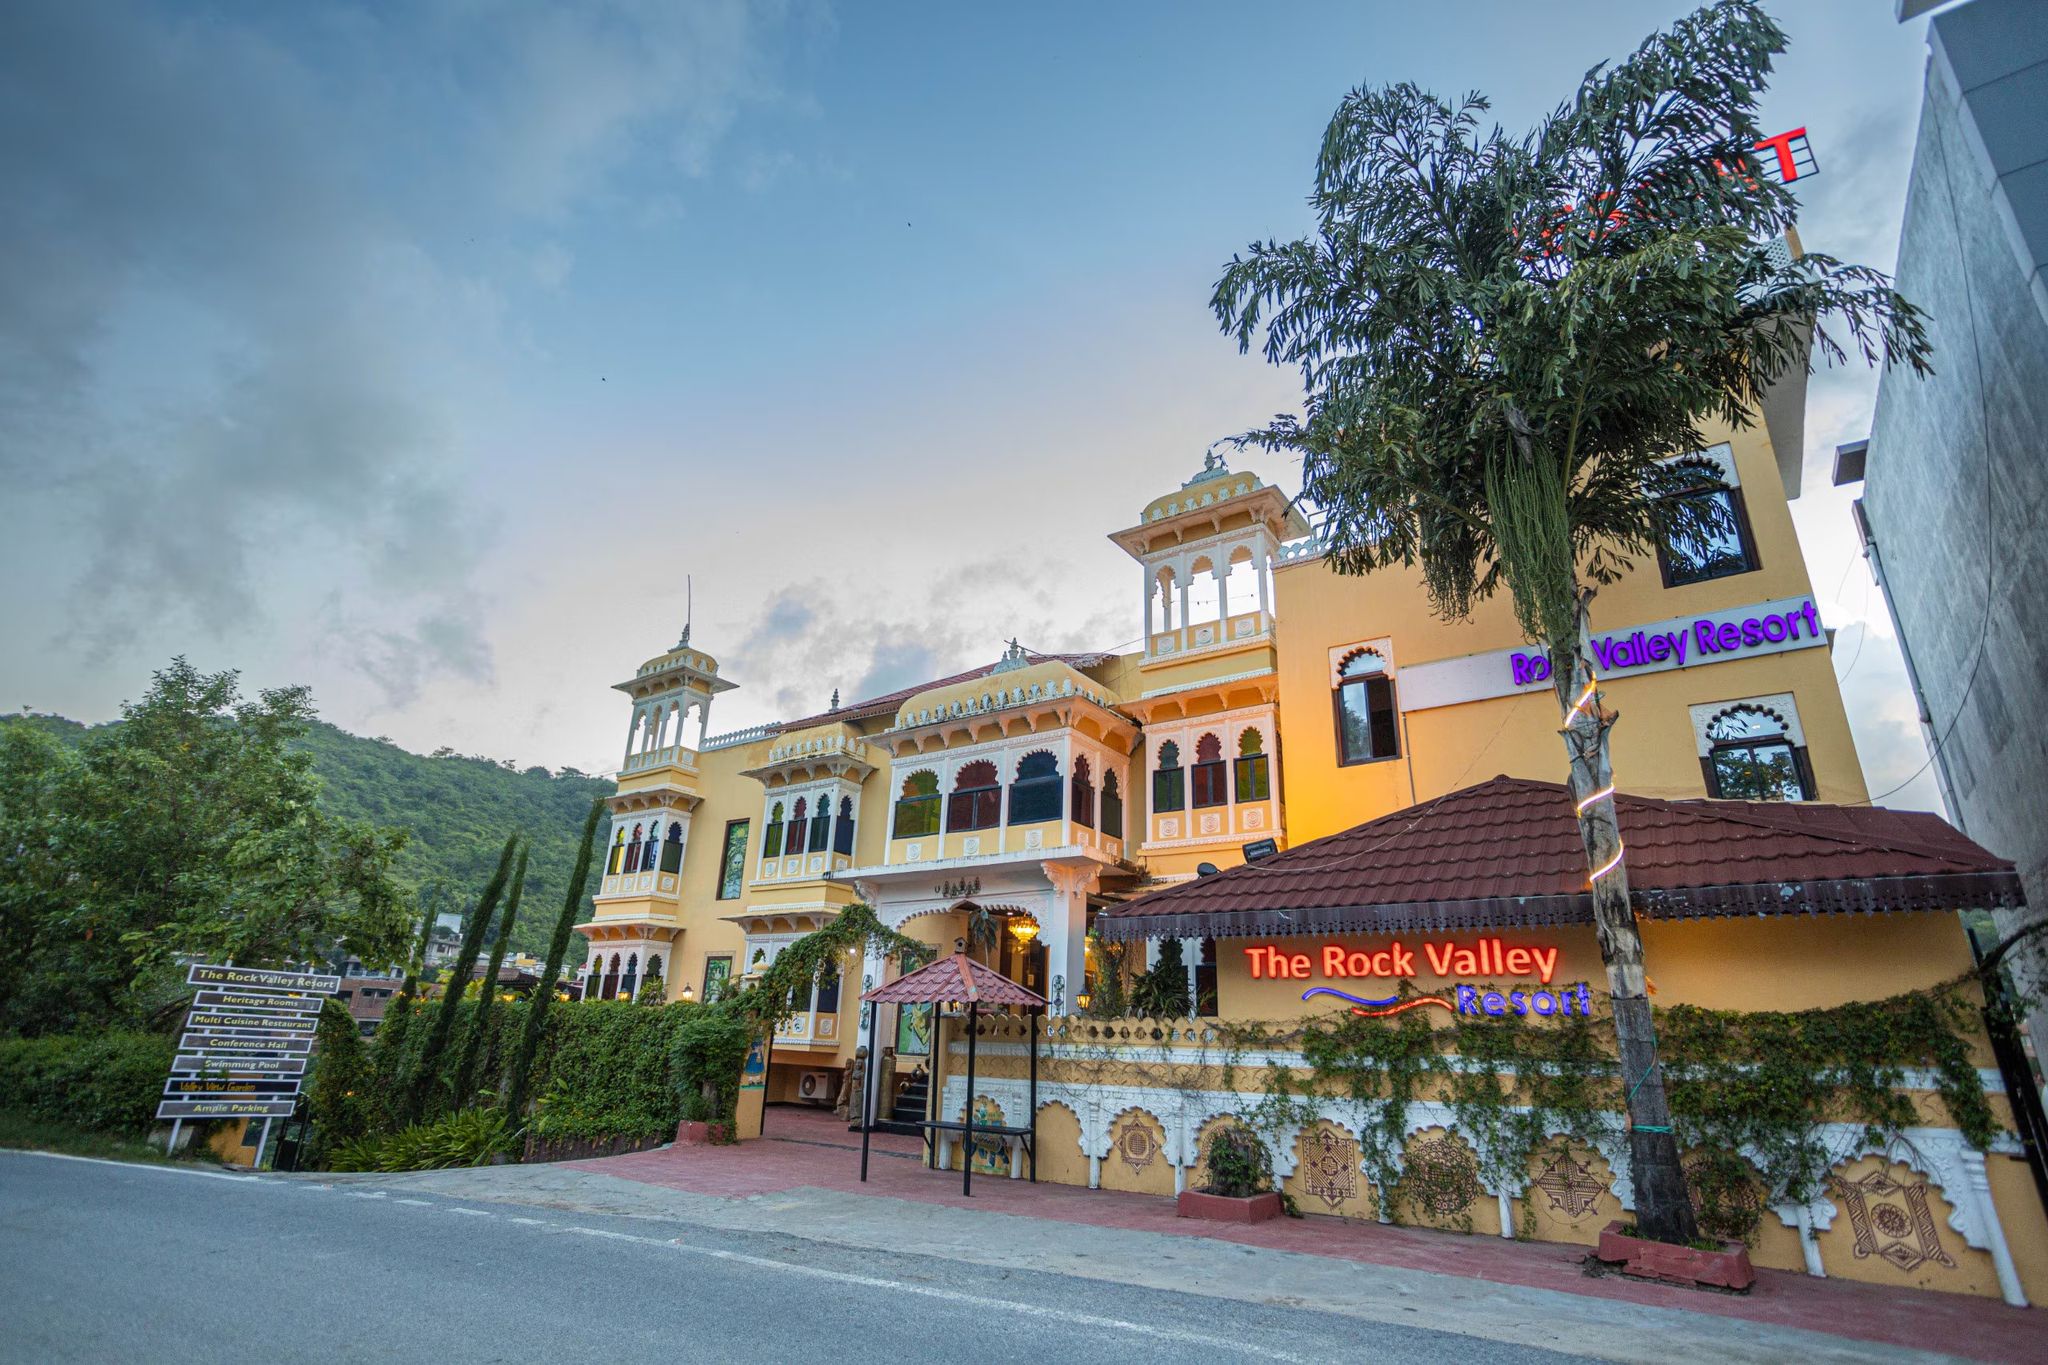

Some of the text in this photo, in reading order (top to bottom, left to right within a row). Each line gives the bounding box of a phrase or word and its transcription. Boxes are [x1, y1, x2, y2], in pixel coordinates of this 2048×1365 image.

[1510, 600, 1820, 686] Ro Valley Resort
[1244, 938, 1558, 984] The Rock Valley
[199, 969, 335, 989] The Rock Valley Resort
[222, 995, 299, 1007] Heritage Rooms
[1456, 982, 1592, 1017] Resort
[194, 1015, 312, 1029] Multi Cuisine Restaurant
[209, 1038, 288, 1049] Conference Hall
[204, 1059, 280, 1070] Swimming Pool
[193, 1104, 269, 1113] Ample Parking
